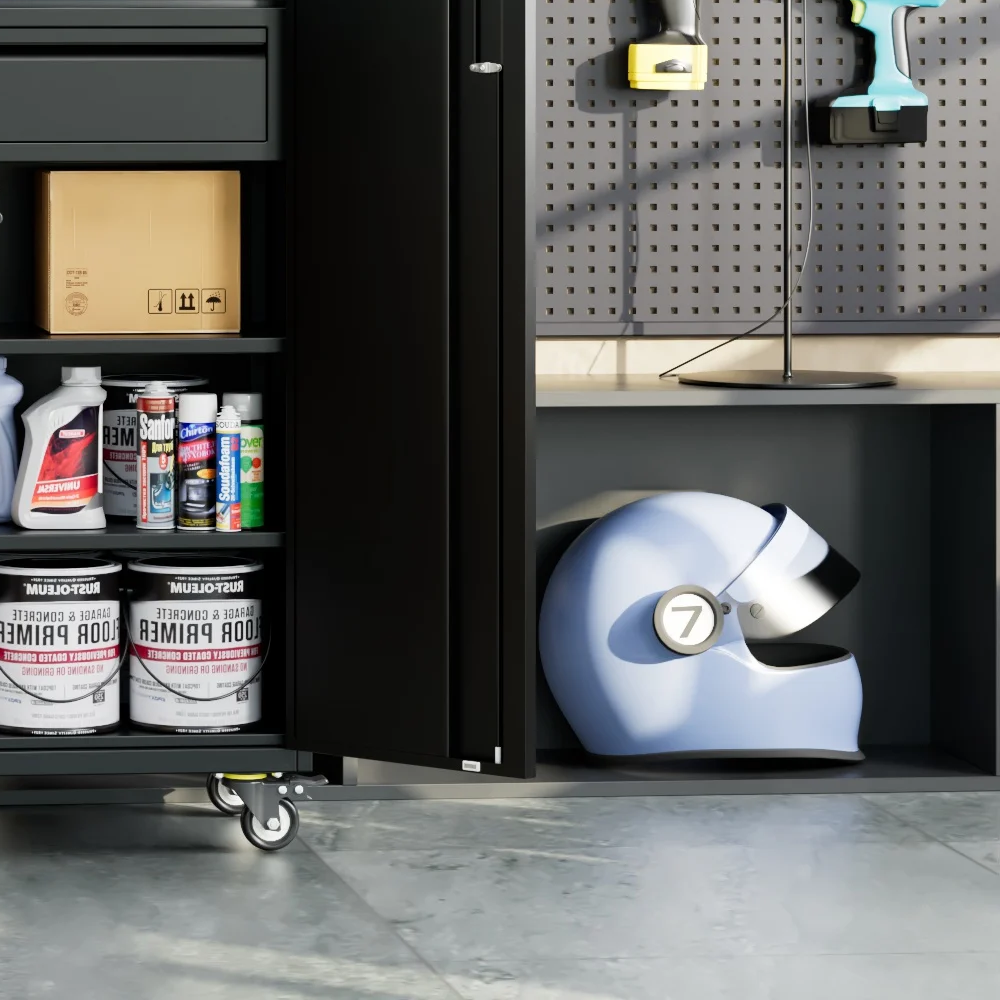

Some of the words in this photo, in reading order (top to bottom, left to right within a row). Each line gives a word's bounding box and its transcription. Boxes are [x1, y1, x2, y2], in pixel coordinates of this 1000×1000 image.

[180, 424, 213, 439] Chirton
[219, 437, 230, 502] Soudafoam
[671, 605, 703, 639] 7
